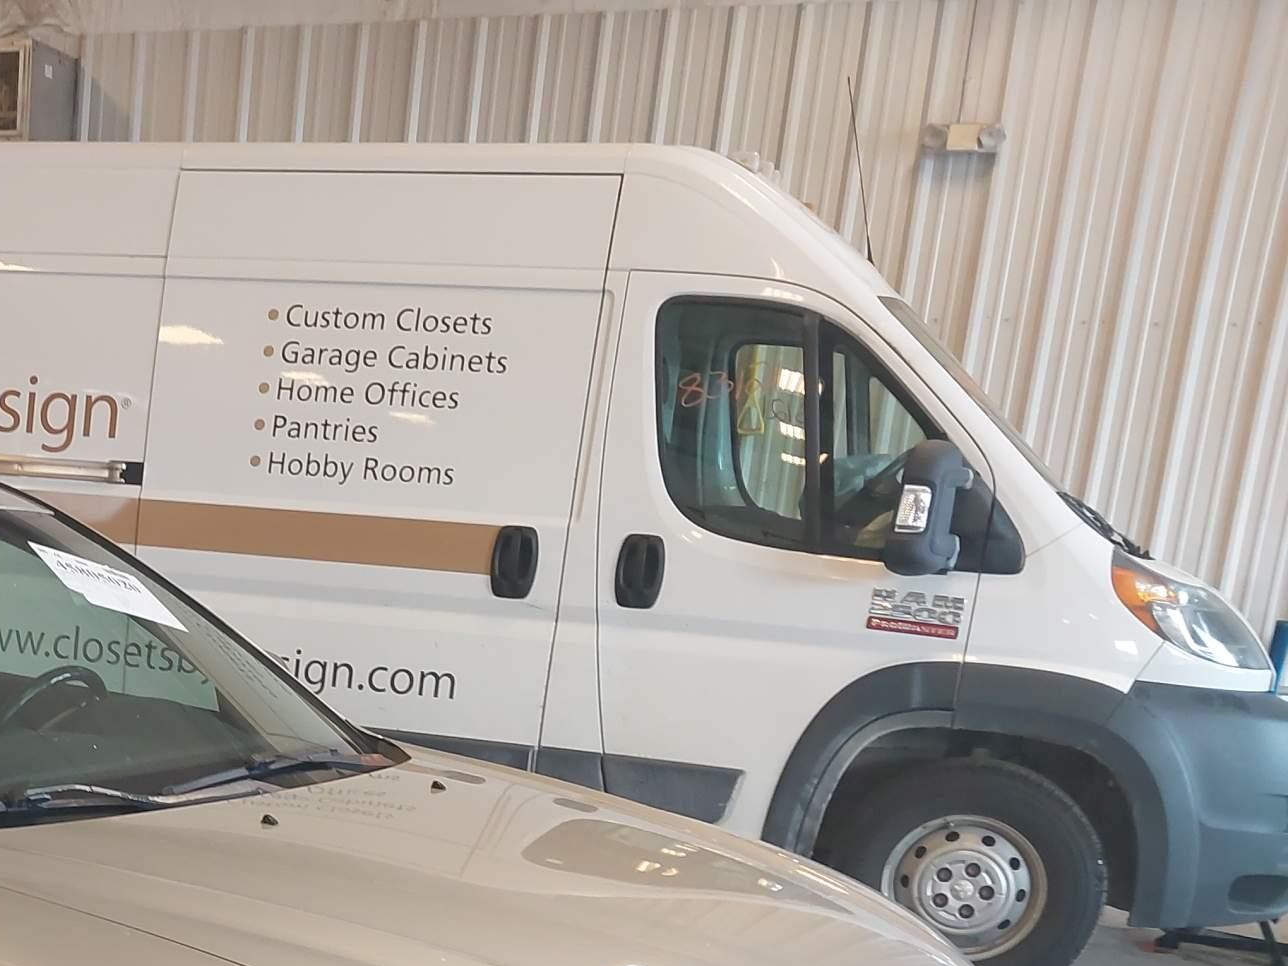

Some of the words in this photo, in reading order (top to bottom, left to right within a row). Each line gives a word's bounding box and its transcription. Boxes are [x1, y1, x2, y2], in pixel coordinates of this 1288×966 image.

[285, 304, 385, 330] Custom
[396, 307, 493, 335] Closets
[281, 341, 378, 373] Garage
[387, 345, 508, 374] Cabinets
[276, 377, 355, 404] Home
[365, 381, 460, 409] Offices
[272, 414, 379, 443] Pantries
[267, 451, 354, 485] Hobby
[363, 457, 455, 485] Rooms
